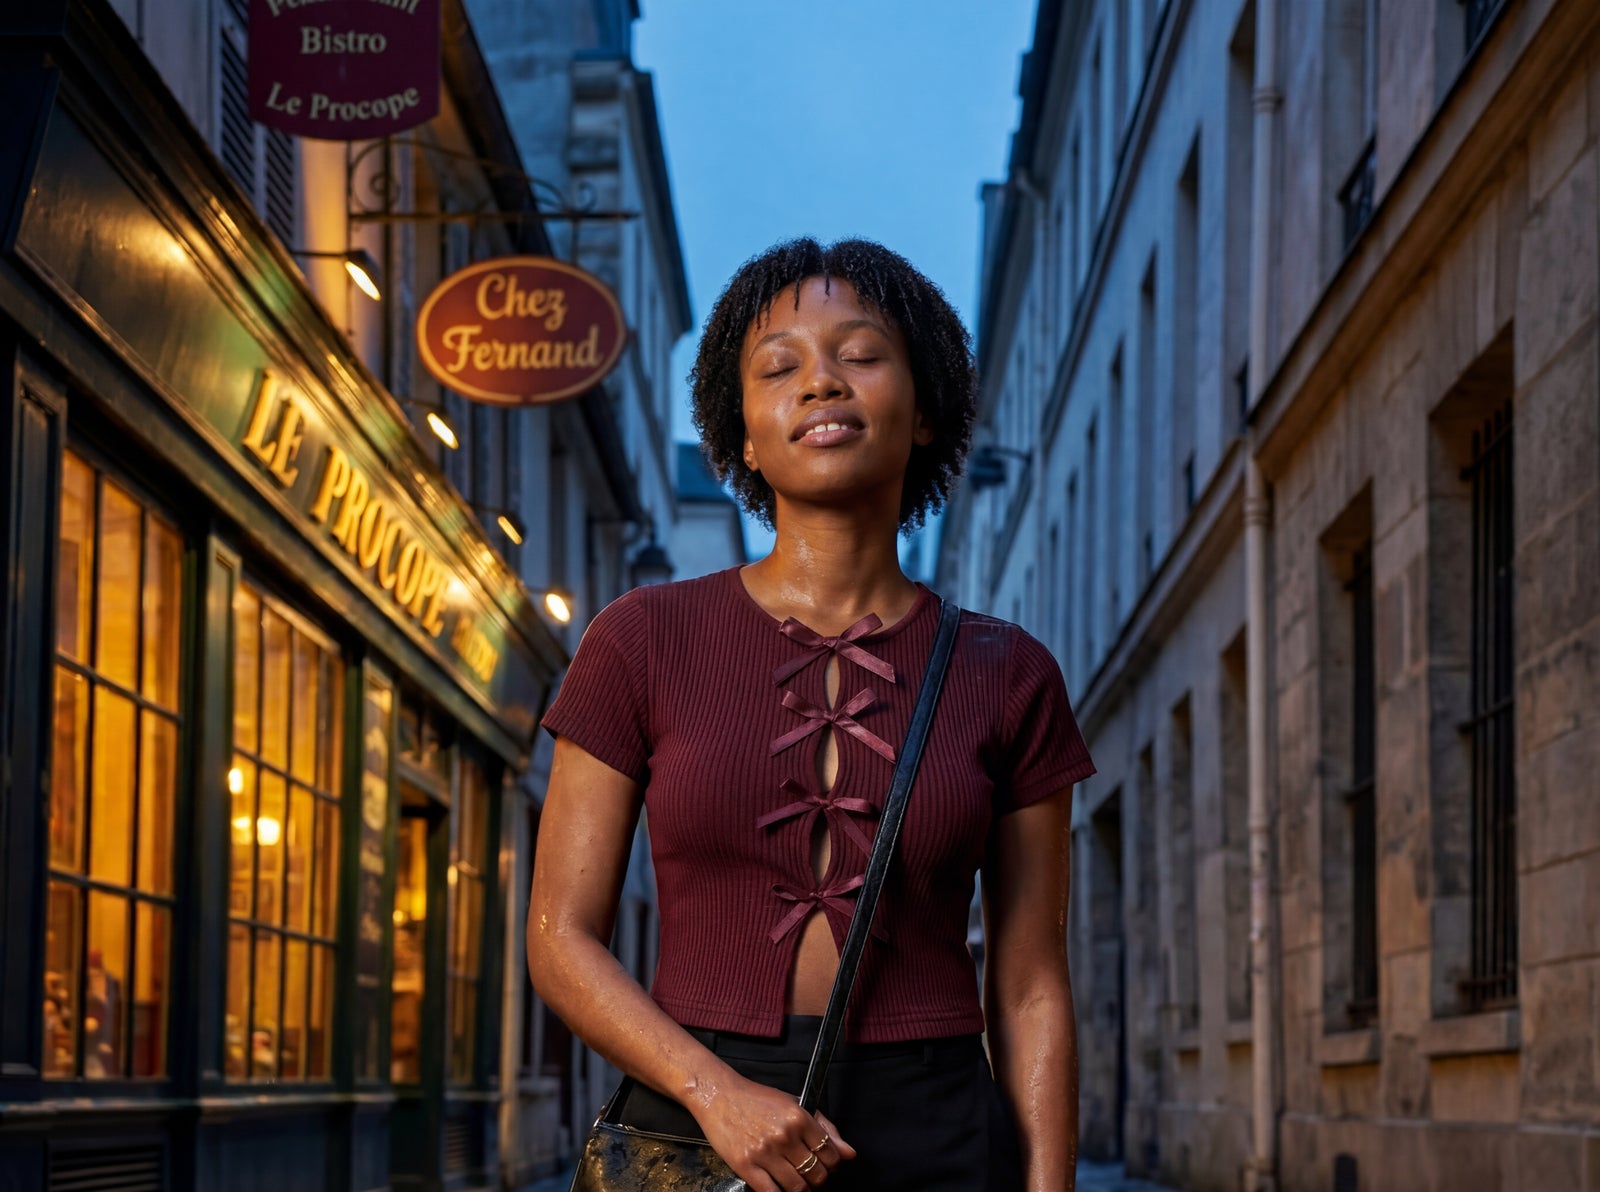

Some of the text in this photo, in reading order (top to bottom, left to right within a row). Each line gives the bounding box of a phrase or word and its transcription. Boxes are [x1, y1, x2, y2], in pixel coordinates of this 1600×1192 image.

[300, 26, 387, 55] Bistro
[266, 82, 420, 121] Le Procope
[477, 274, 566, 331] Chez
[442, 325, 601, 374] Fernand
[243, 370, 454, 638] LE PROCOPE
